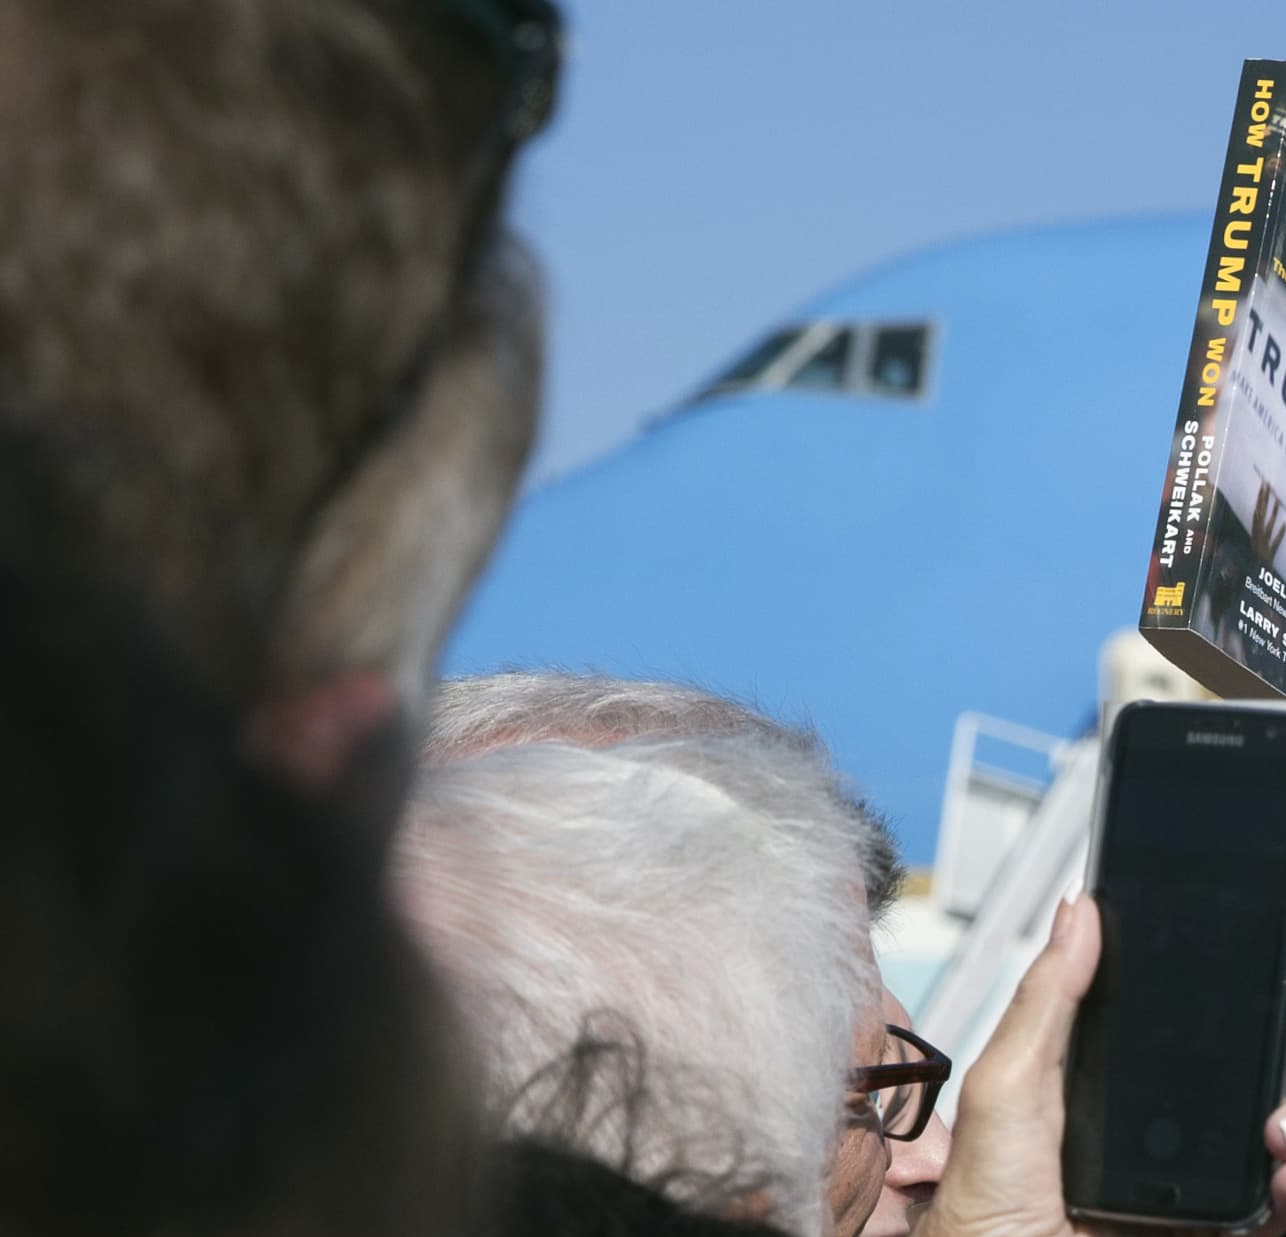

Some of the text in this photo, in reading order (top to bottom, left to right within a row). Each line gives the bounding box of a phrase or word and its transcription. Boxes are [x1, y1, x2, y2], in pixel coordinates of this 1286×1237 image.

[1197, 79, 1275, 407] HOW TRUMP WON
[1159, 420, 1199, 569] SCHWEIKART
[1183, 435, 1215, 555] POLLAK AND
[1245, 576, 1273, 607] Breitbart
[1259, 567, 1286, 599] JOEL
[1240, 600, 1280, 638] LARRY
[1249, 627, 1266, 647] New
[1266, 640, 1281, 659] York
